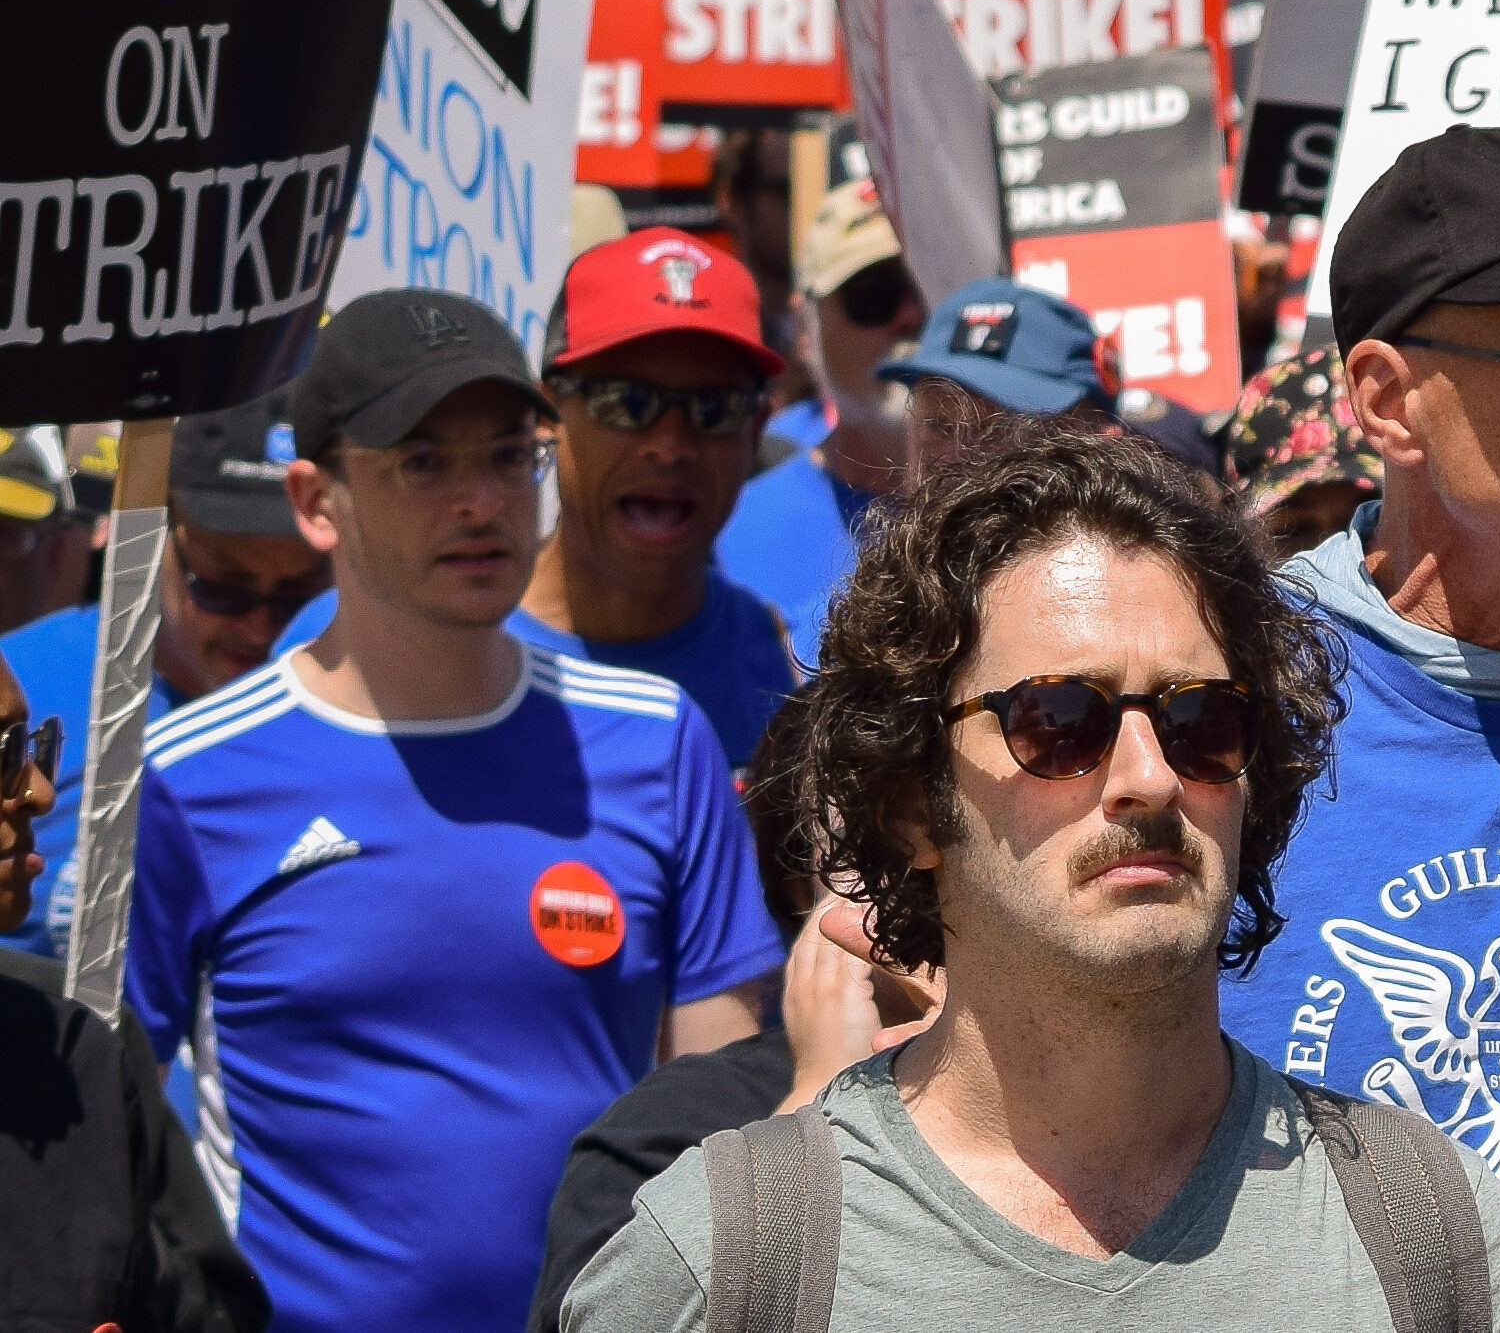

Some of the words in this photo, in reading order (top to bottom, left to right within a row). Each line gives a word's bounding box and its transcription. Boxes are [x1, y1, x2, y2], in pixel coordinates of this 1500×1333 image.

[105, 23, 229, 147] ON
[1053, 86, 1191, 139] GUILD
[0, 145, 351, 346] TRIKE
